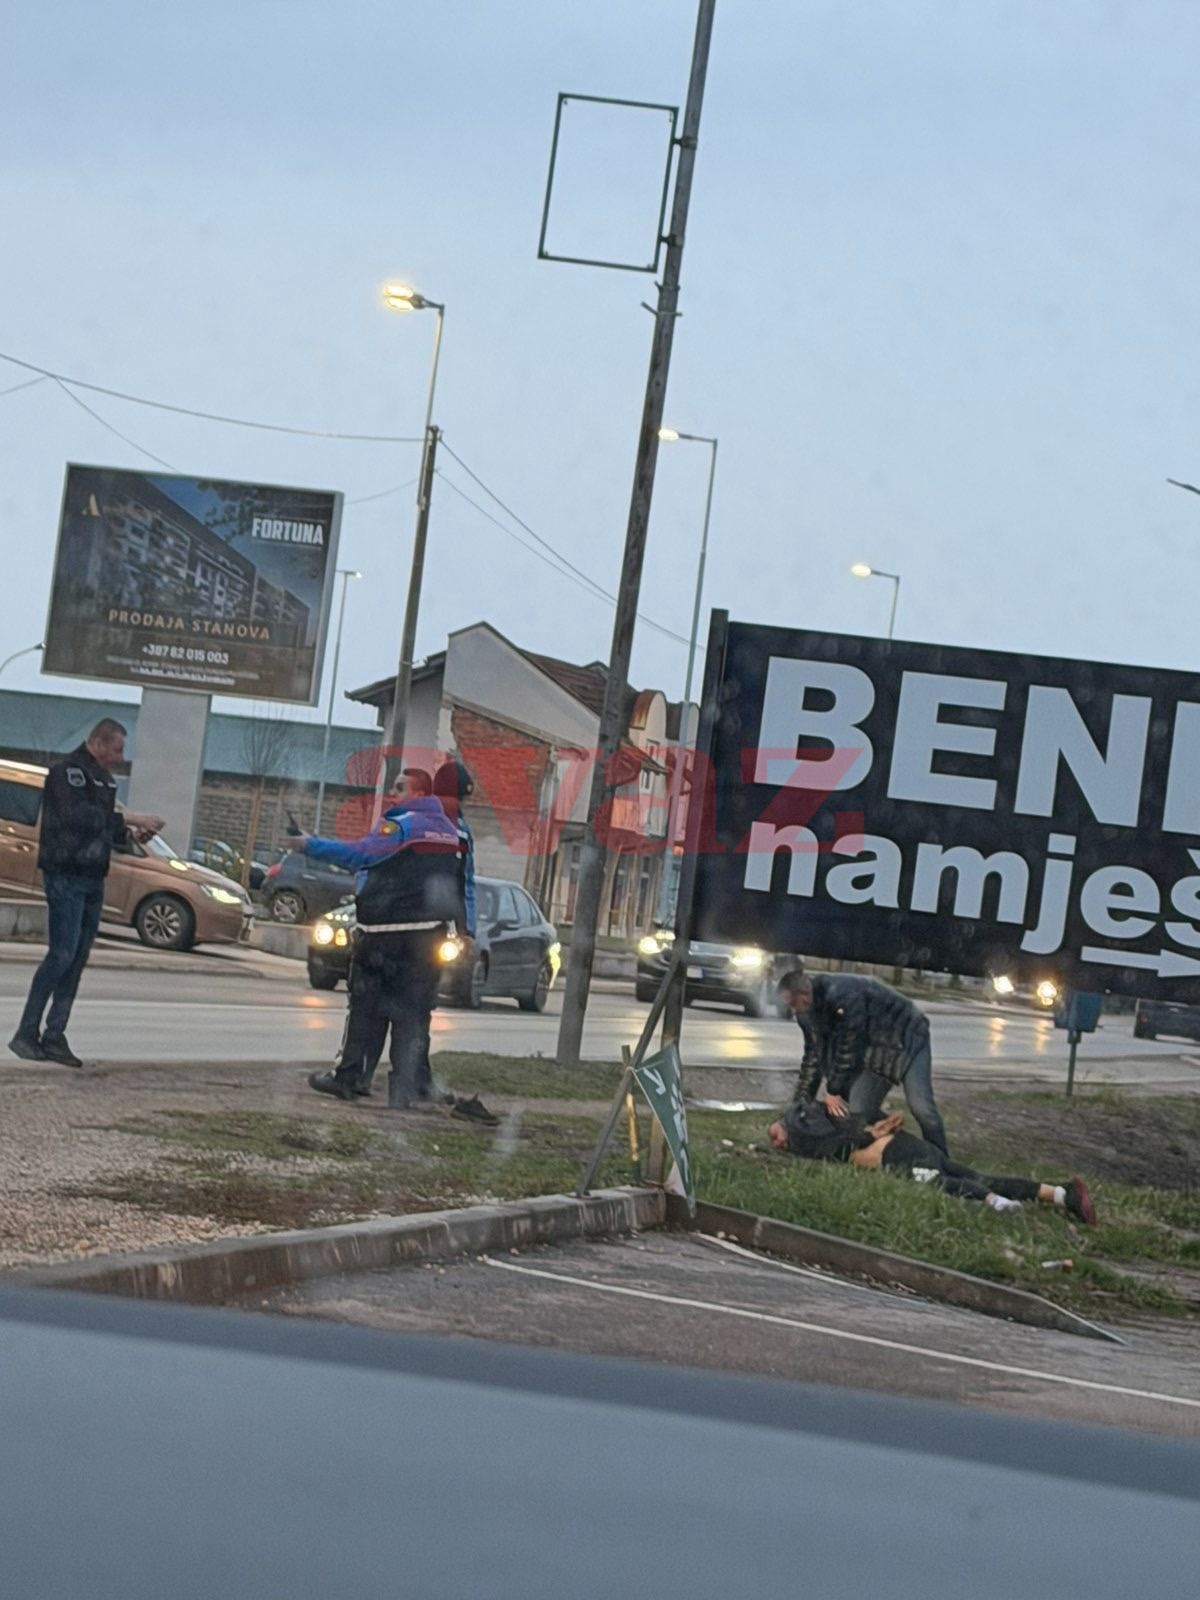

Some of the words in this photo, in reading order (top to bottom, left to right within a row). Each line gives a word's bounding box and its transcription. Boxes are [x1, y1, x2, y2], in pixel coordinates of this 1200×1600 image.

[252, 517, 323, 546] FORTUNA
[108, 609, 185, 630] PRODAJA
[192, 619, 270, 640] STANOVA
